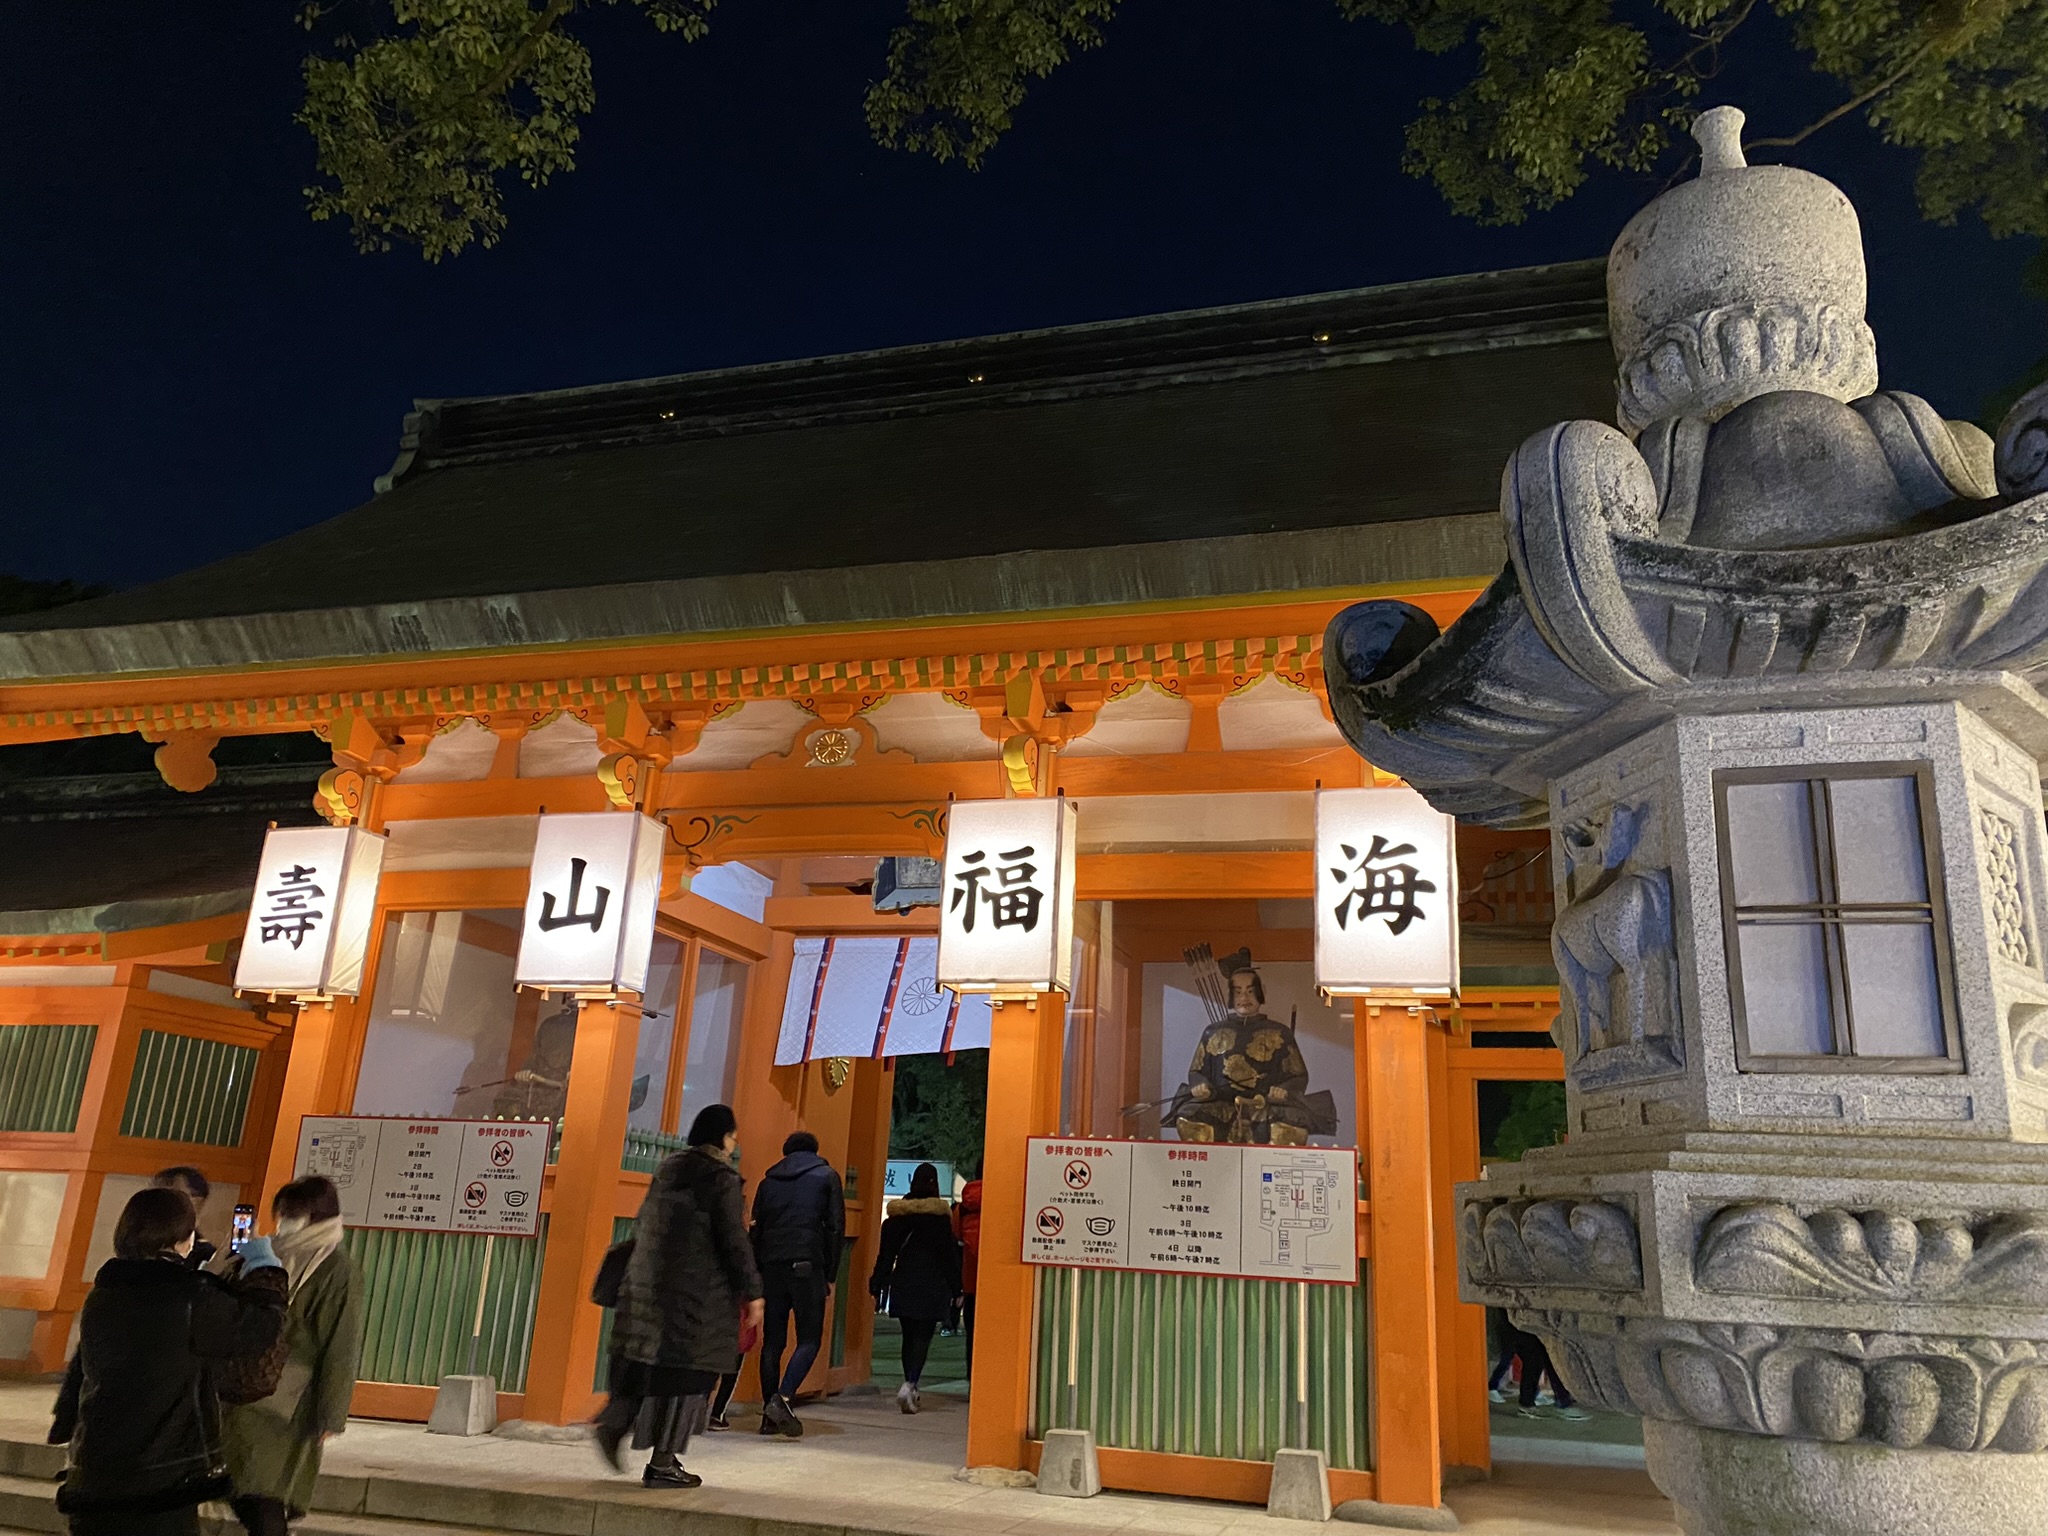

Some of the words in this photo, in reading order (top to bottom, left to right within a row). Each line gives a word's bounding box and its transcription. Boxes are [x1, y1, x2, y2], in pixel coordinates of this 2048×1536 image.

[950, 845, 1045, 933] 福
[1330, 835, 1437, 936] 海
[538, 857, 611, 934] 山
[259, 864, 326, 951] 壽
[408, 1125, 439, 1135] 参拝時間
[478, 1127, 533, 1138] 参拝者の皆様へ
[1045, 1145, 1113, 1157] 参拝者の皆様へ
[1167, 1150, 1208, 1161] 参拝時間
[1172, 1179, 1202, 1188] 終日開門
[1168, 1244, 1179, 1252] 4日
[1187, 1245, 1202, 1253] 以降
